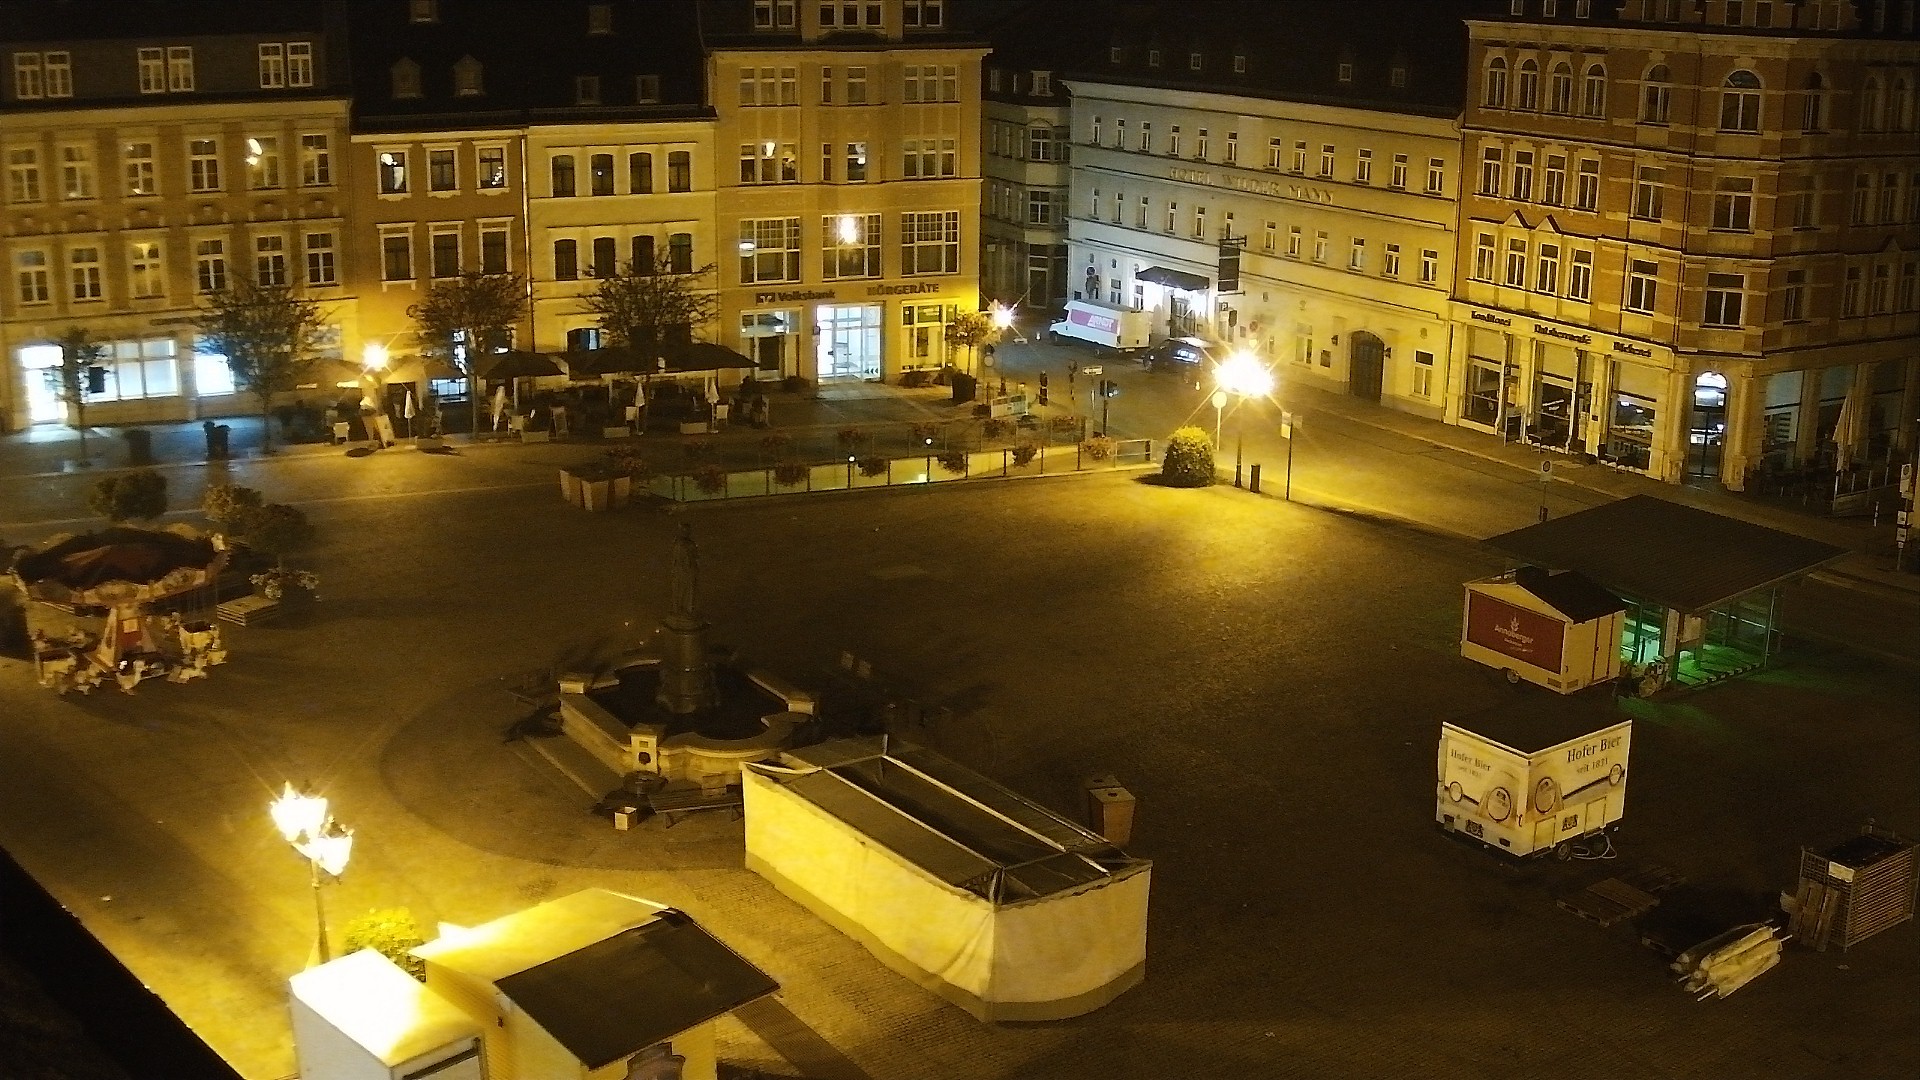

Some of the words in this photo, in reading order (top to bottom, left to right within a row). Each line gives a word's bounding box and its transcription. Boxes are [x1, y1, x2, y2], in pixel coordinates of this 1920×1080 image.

[1170, 166, 1213, 185] HOTEL
[1223, 175, 1280, 194] WILDER
[1289, 185, 1334, 204] MANN
[778, 290, 835, 301] Volksbank
[867, 282, 939, 295] HÖRGERÄTE
[1471, 310, 1512, 326] Konditorei
[1567, 743, 1598, 763] Hofer
[1600, 736, 1621, 752] Bier
[1451, 748, 1472, 763] Hofer
[1475, 758, 1491, 772] Bier
